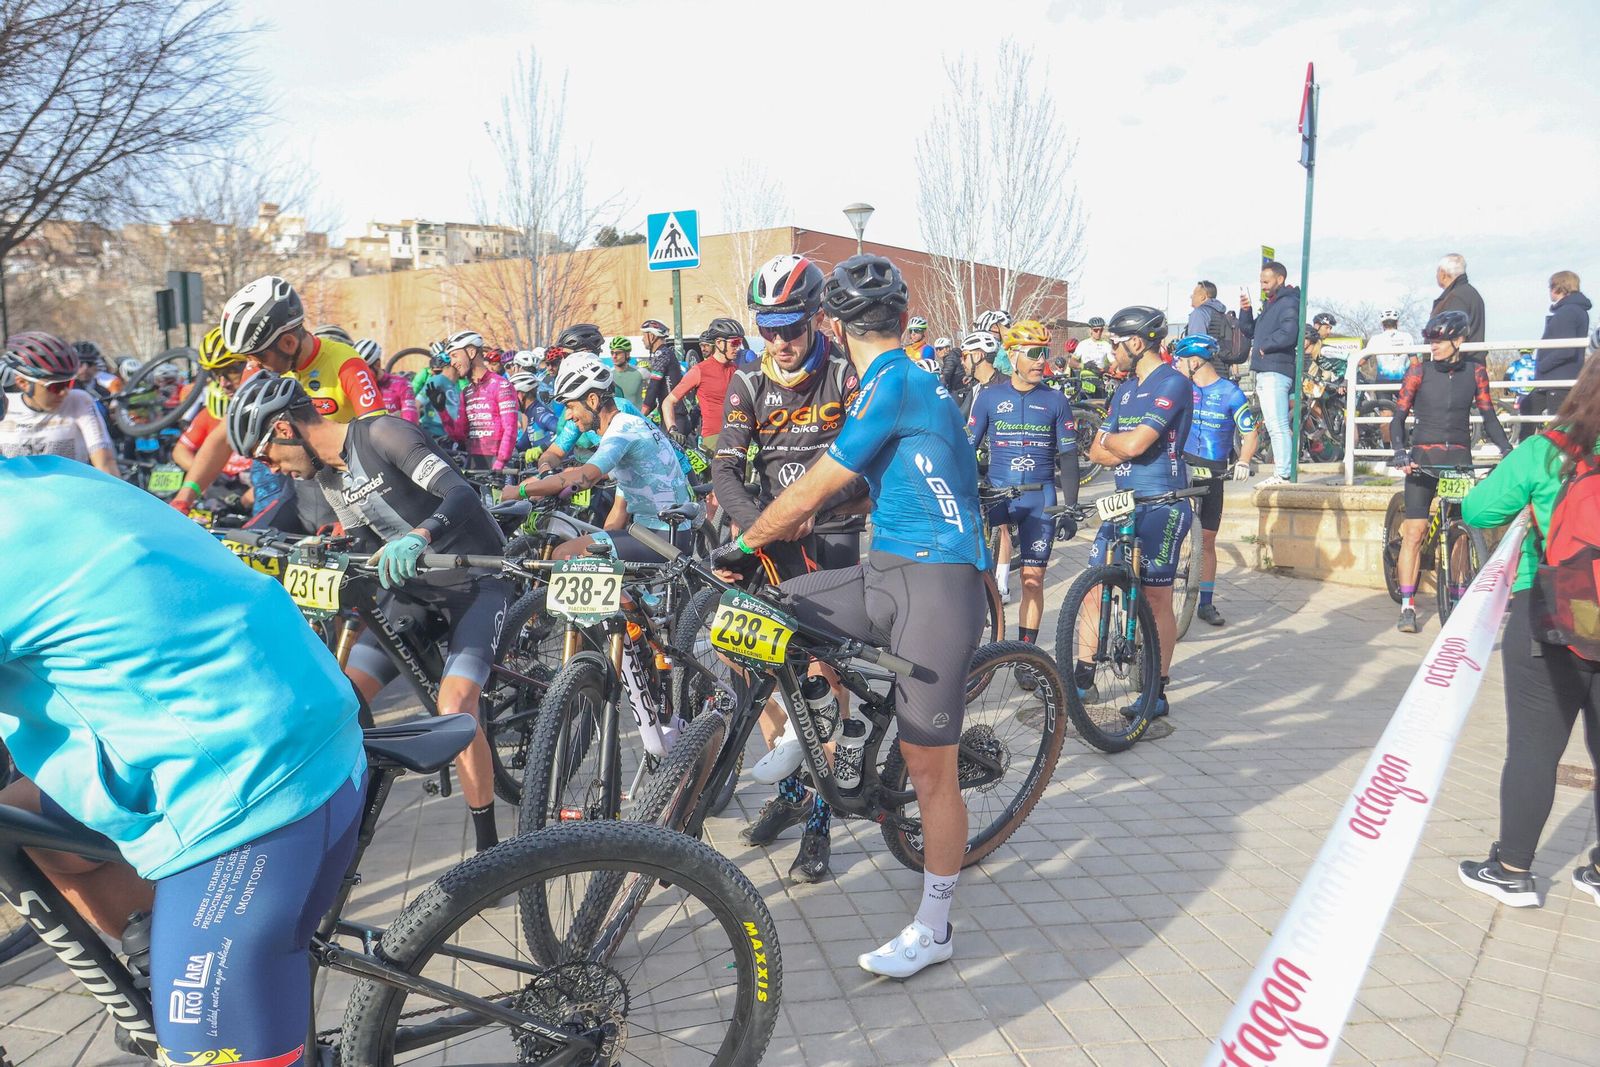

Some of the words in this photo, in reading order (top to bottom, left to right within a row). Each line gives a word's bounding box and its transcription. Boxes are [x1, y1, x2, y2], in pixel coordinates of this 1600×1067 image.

[791, 424, 819, 434] bike
[926, 477, 964, 533] GIST
[1102, 492, 1129, 514] 1020
[289, 568, 337, 603] 231-1
[553, 576, 617, 606] 238-2
[716, 610, 785, 656] 238-1
[1424, 637, 1481, 687] octagon
[791, 690, 830, 778] cannondale
[1348, 753, 1429, 840] octagon
[201, 873, 231, 930] PRECOCINADOS
[214, 894, 233, 924] FRUTAS
[231, 844, 252, 886] VERDURAS
[234, 854, 268, 915] (MONTORO)
[192, 897, 210, 927] CARNES
[0, 890, 165, 1066] S-WORK
[173, 951, 215, 989] LARA
[743, 921, 769, 1003] MAXXIS
[169, 989, 204, 1025] PACO
[520, 1021, 568, 1042] EPIC
